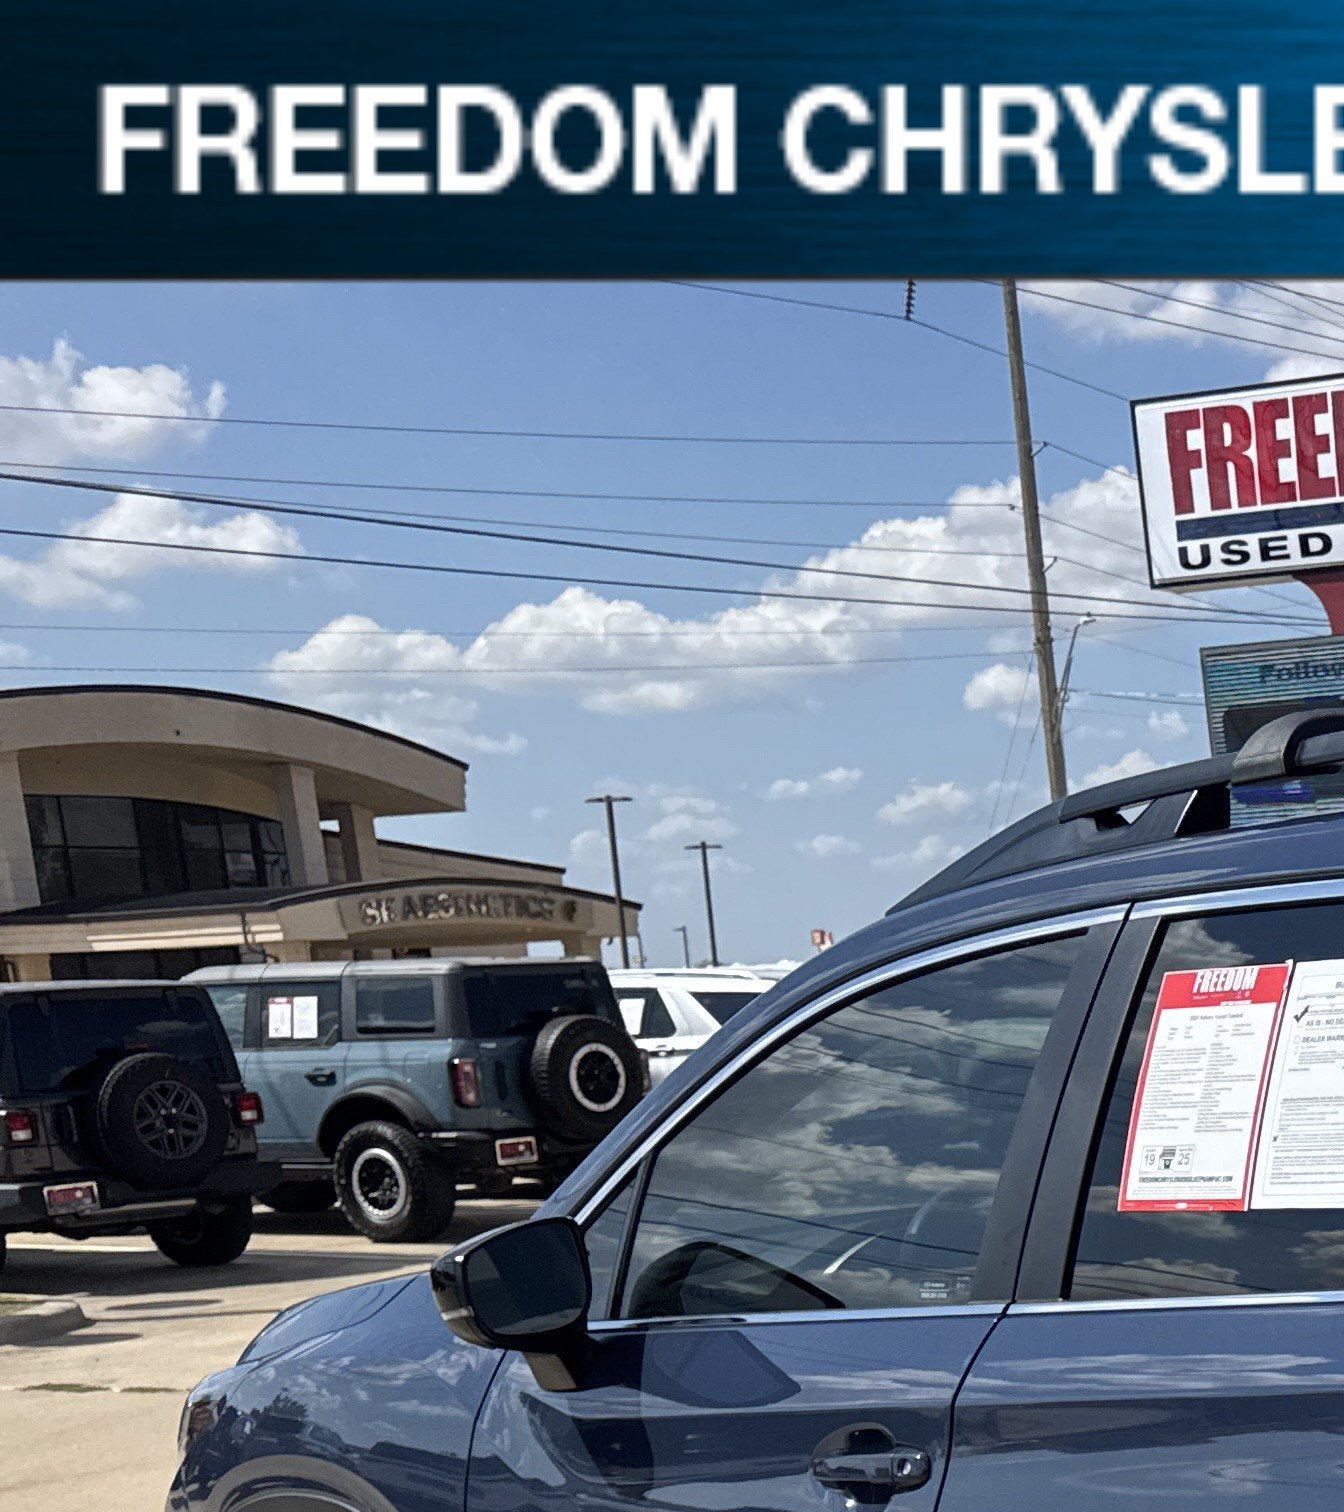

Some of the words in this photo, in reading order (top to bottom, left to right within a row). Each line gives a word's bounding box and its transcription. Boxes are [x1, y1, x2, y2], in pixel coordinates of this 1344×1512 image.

[1177, 530, 1333, 570] USED
[1191, 967, 1260, 994] FREEDOM
[1144, 1154, 1156, 1166] 19
[1177, 1153, 1191, 1166] 25
